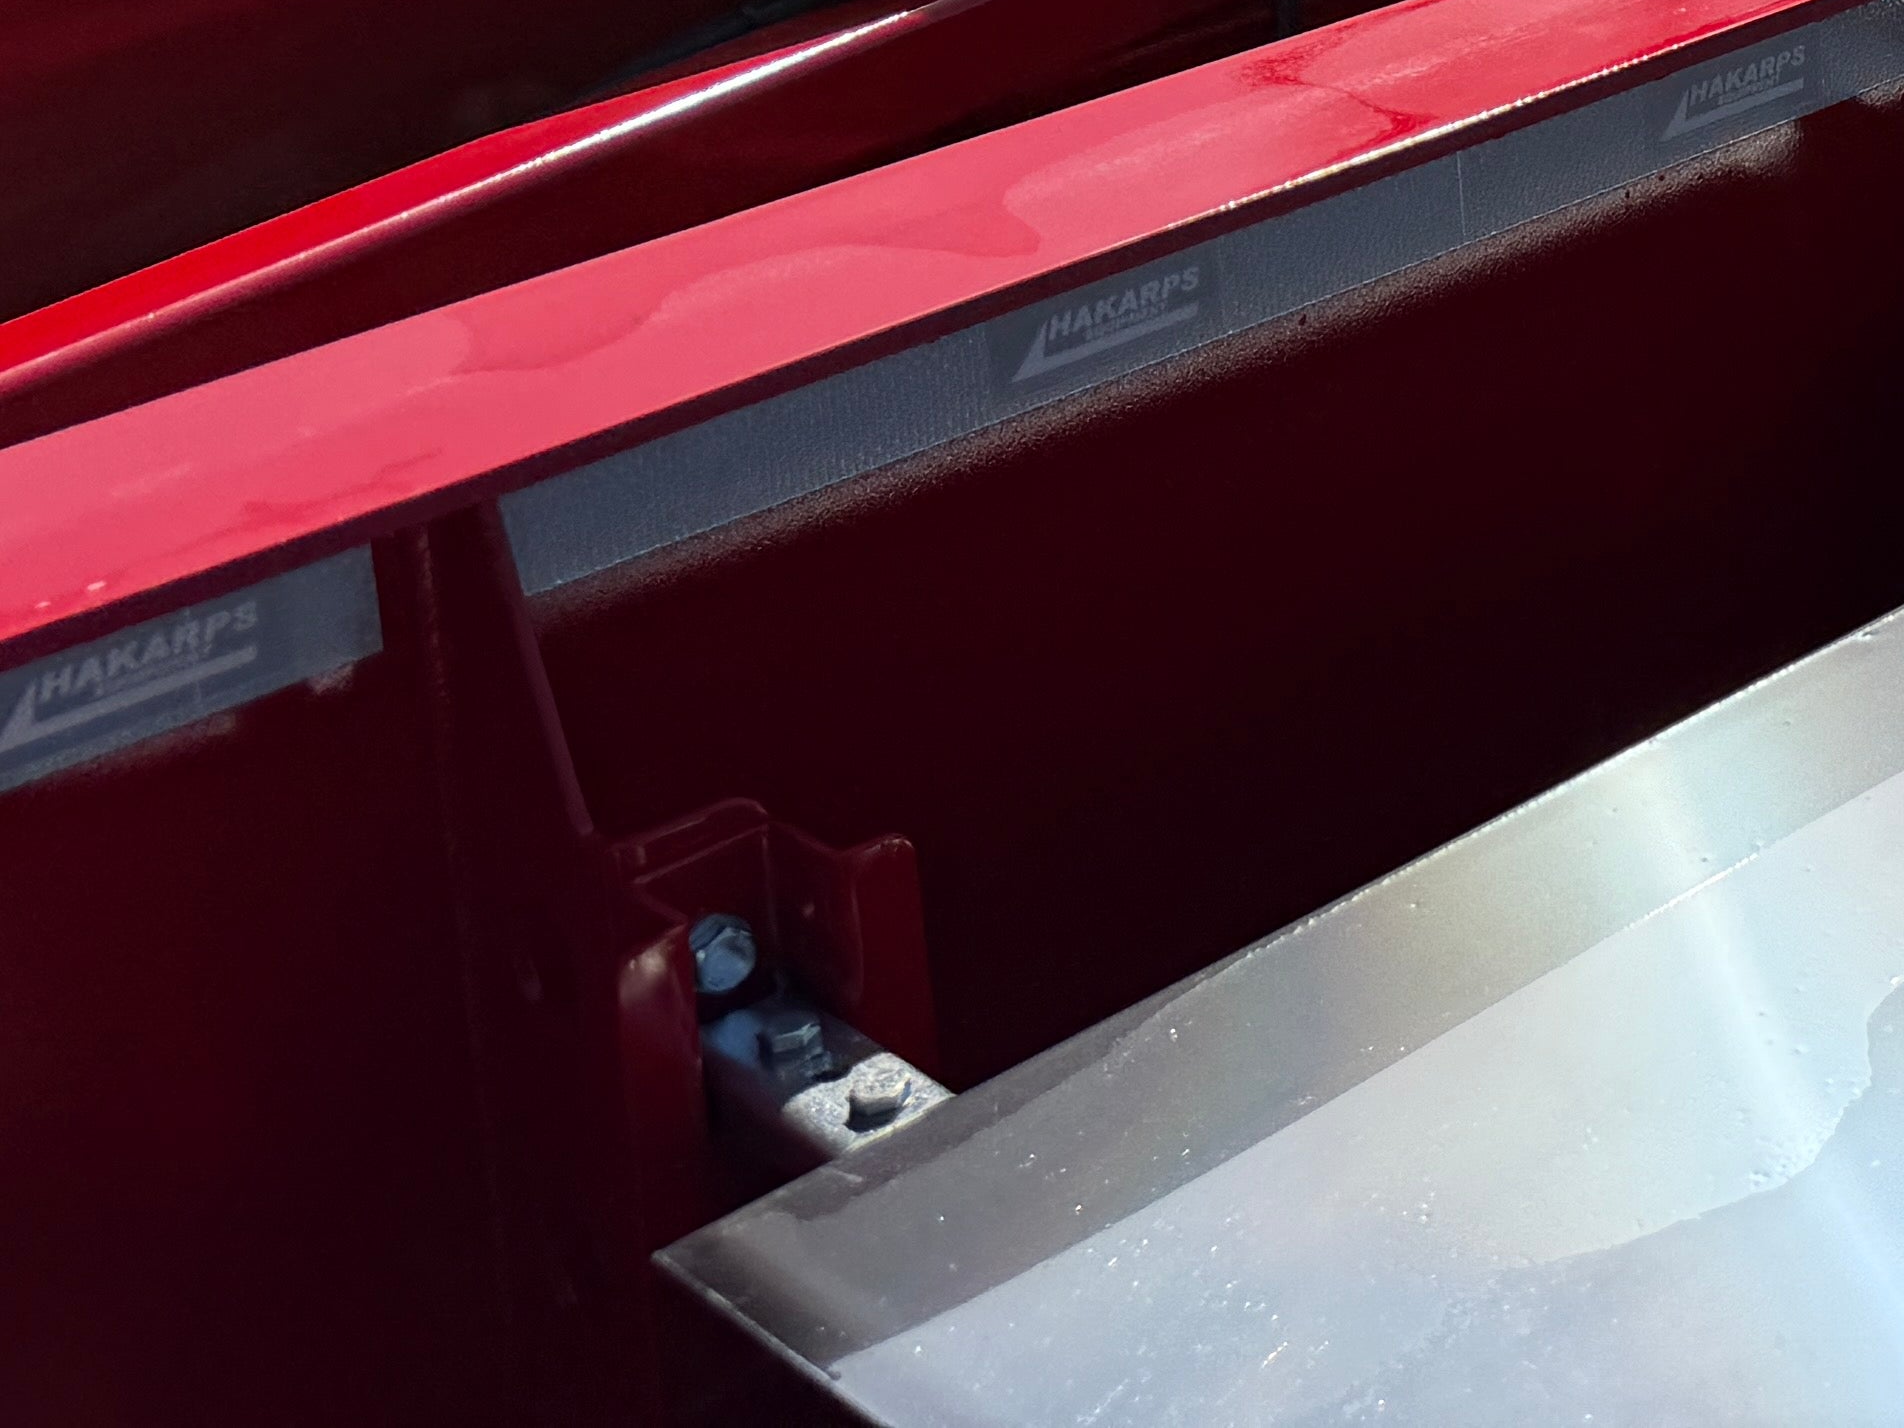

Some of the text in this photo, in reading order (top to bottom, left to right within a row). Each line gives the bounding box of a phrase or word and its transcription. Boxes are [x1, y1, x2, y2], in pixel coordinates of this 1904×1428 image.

[1689, 44, 1806, 106] HAKARPS
[1048, 266, 1201, 341] HAKARPS
[38, 599, 259, 704] HAKARPS
